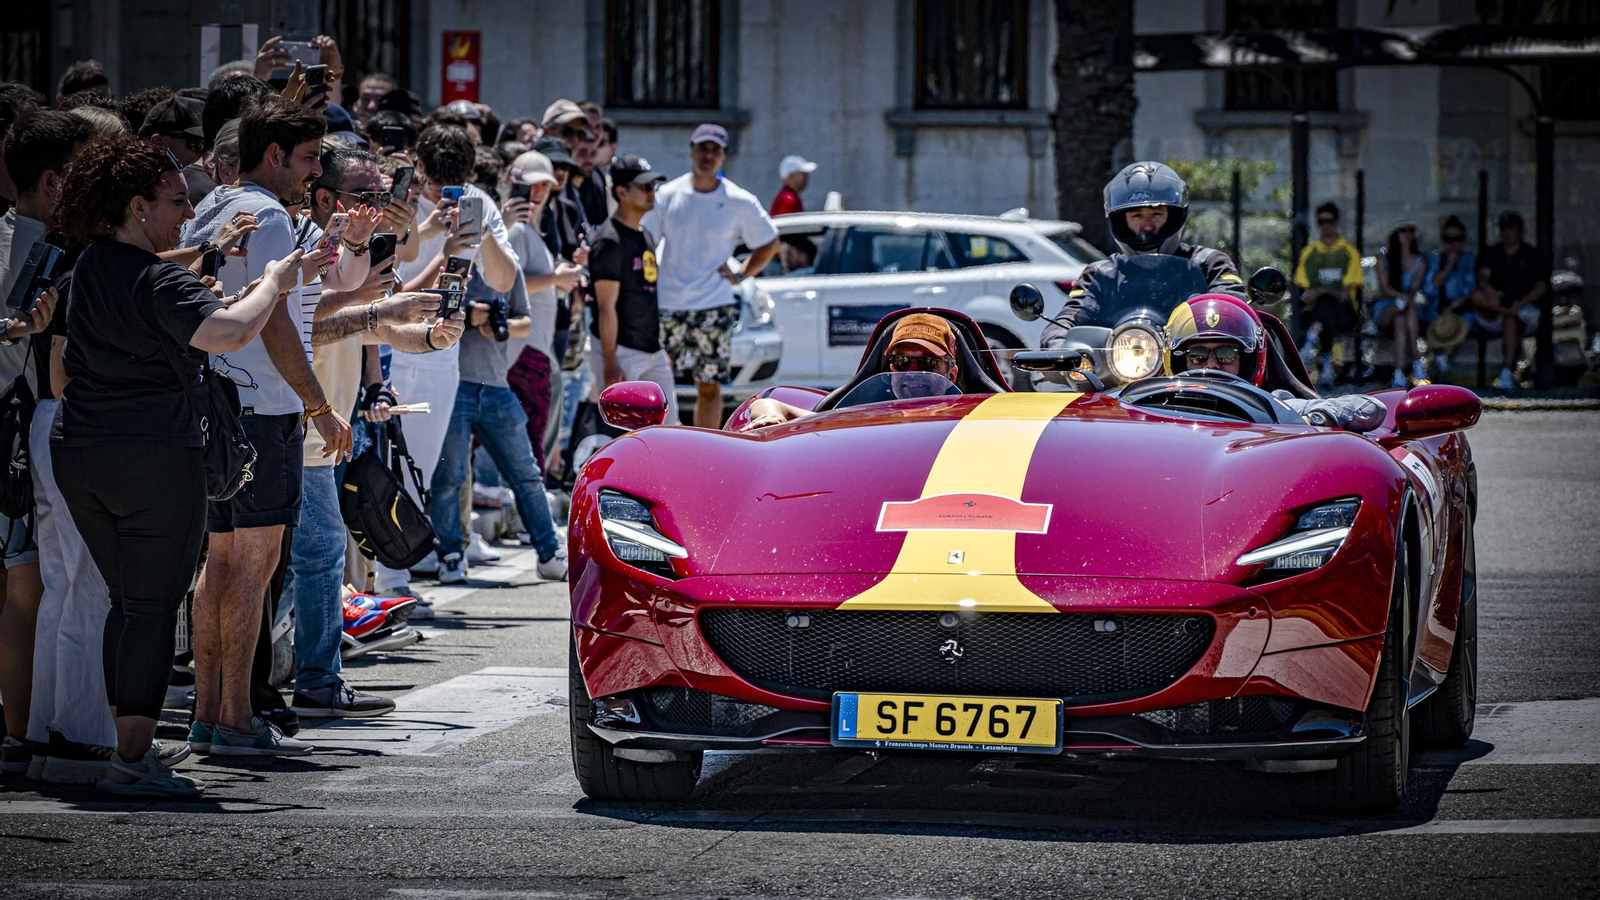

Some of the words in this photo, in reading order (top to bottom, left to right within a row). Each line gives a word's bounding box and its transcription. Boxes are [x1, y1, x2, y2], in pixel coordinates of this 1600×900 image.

[842, 719, 850, 731] L
[876, 701, 924, 734] SF
[935, 703, 1037, 739] 6767
[885, 740, 928, 749] Francorchamps
[982, 744, 1018, 752] Luxembourg
